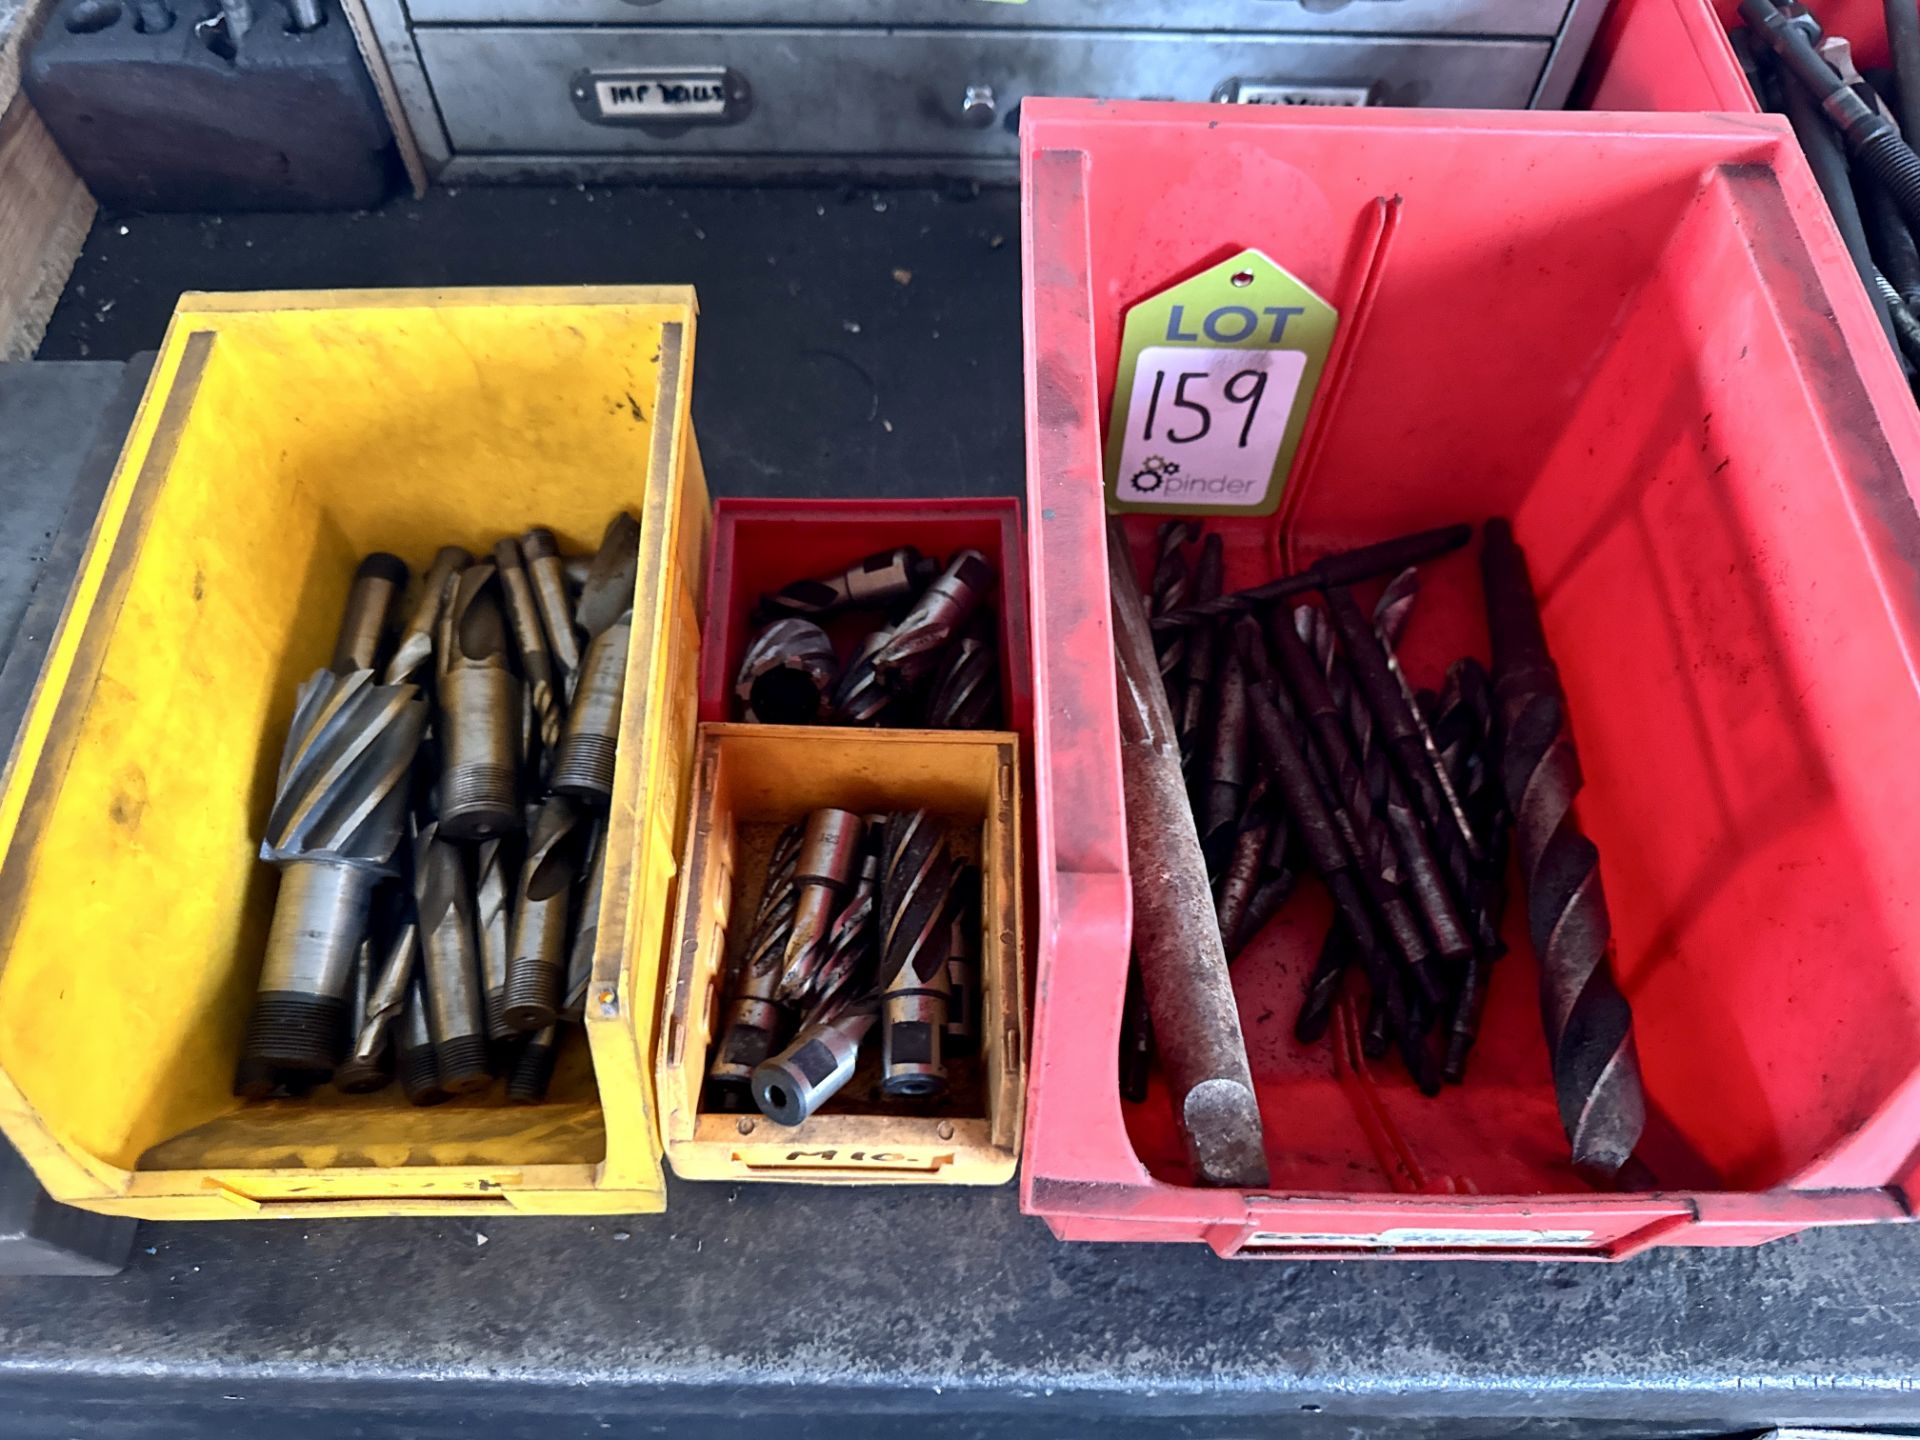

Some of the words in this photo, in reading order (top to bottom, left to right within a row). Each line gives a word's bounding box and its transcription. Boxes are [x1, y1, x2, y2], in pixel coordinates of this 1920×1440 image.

[1165, 305, 1305, 343] LOT
[1143, 370, 1268, 448] 159
[1163, 474, 1256, 494] pinder
